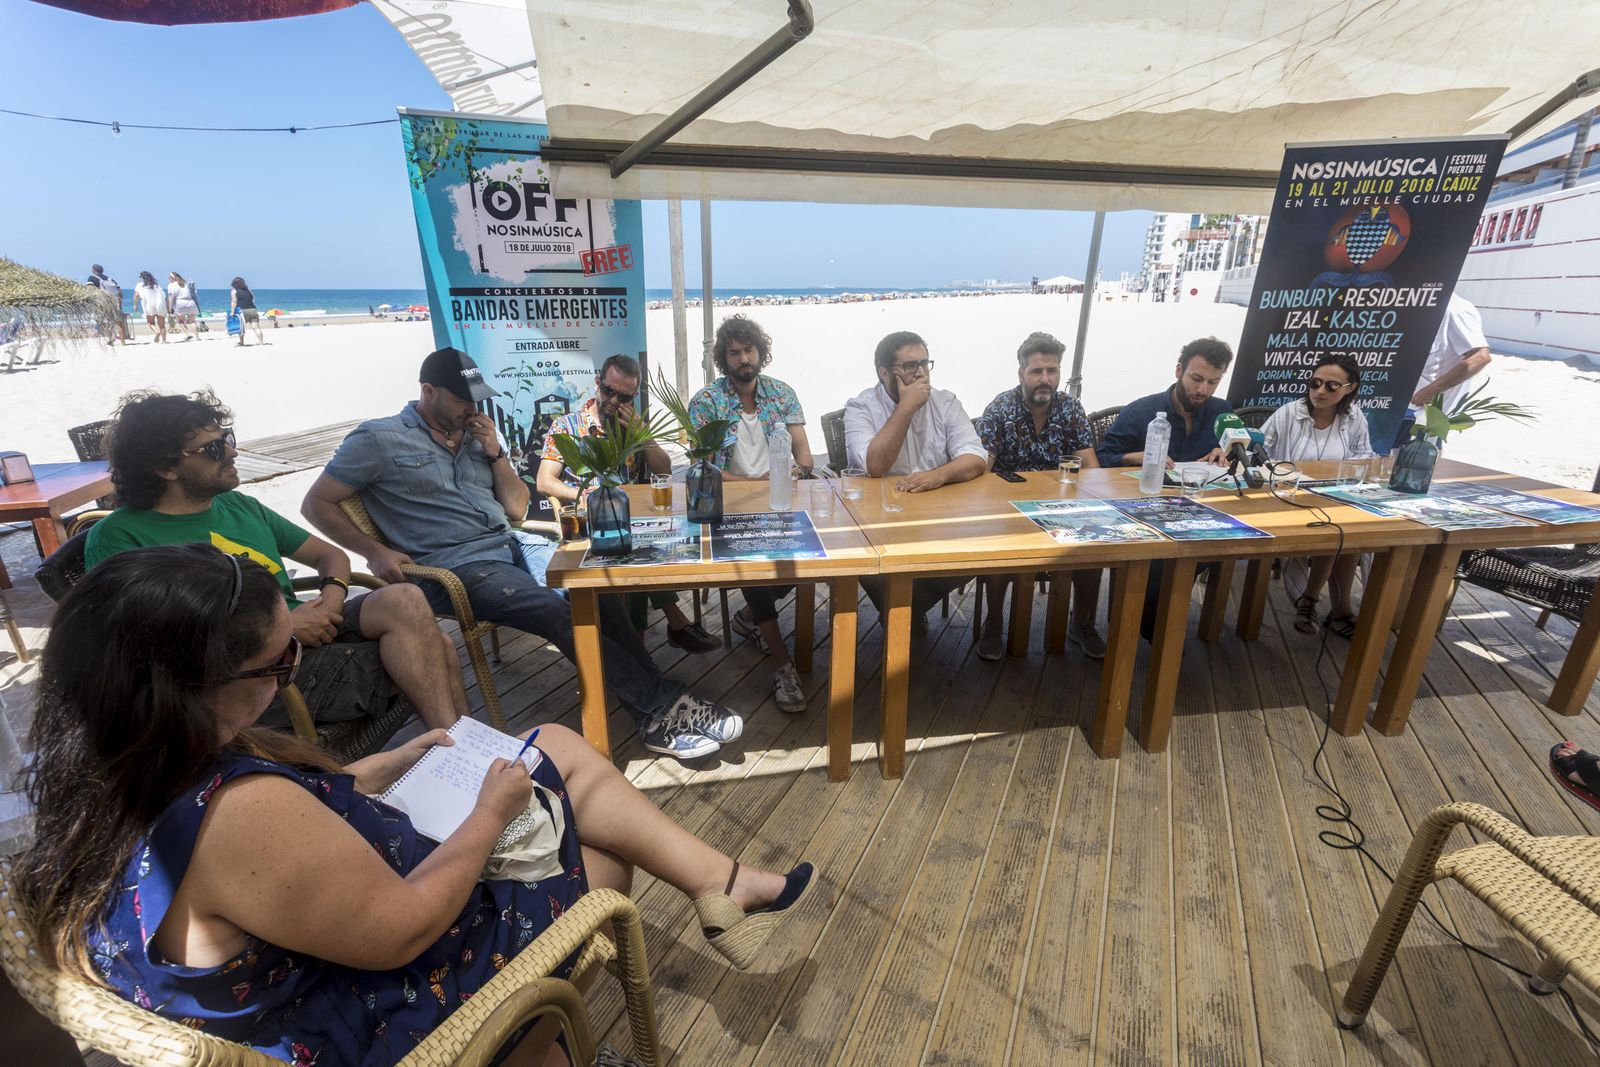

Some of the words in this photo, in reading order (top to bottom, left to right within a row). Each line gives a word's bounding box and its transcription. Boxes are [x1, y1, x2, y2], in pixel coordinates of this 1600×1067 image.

[1450, 154, 1488, 165] FESTIVAL
[1291, 157, 1437, 180] NOSINMÚSICA
[1446, 166, 1473, 174] PUERTO
[1474, 165, 1485, 174] DE
[1288, 182, 1304, 197] 19
[1308, 182, 1325, 197] AL
[1331, 181, 1348, 195] 21
[1353, 179, 1394, 195] JULIO
[1399, 177, 1435, 193] 2018
[1441, 174, 1482, 192] CÁDIZ
[1285, 199, 1303, 209] EN
[1313, 198, 1329, 207] EL
[1340, 195, 1402, 206] MUELLE
[1412, 193, 1475, 204] CIUDAD
[486, 223, 583, 238] NOSINMÚSICA
[509, 243, 519, 252] 18
[520, 244, 530, 252] DE
[532, 244, 552, 252] JULIO
[553, 244, 571, 252] 2018
[581, 247, 632, 275] FREE
[1259, 288, 1340, 309] BUNBURY
[1343, 287, 1442, 307] RESIDENTE
[451, 299, 520, 321] BANDAS
[525, 298, 628, 320] EMERGENTES
[505, 321, 557, 329] MUELLE
[1283, 310, 1322, 330] IZAL
[1329, 310, 1397, 329] KASE.O
[515, 342, 555, 351] ENTRADA
[556, 341, 580, 350] LIBRE
[1266, 332, 1308, 349] MALA
[1314, 330, 1404, 349] RODRÍGUEZ
[1264, 351, 1324, 366] VINTAGE
[1256, 370, 1293, 381] DORIAN
[1261, 383, 1275, 394] LA
